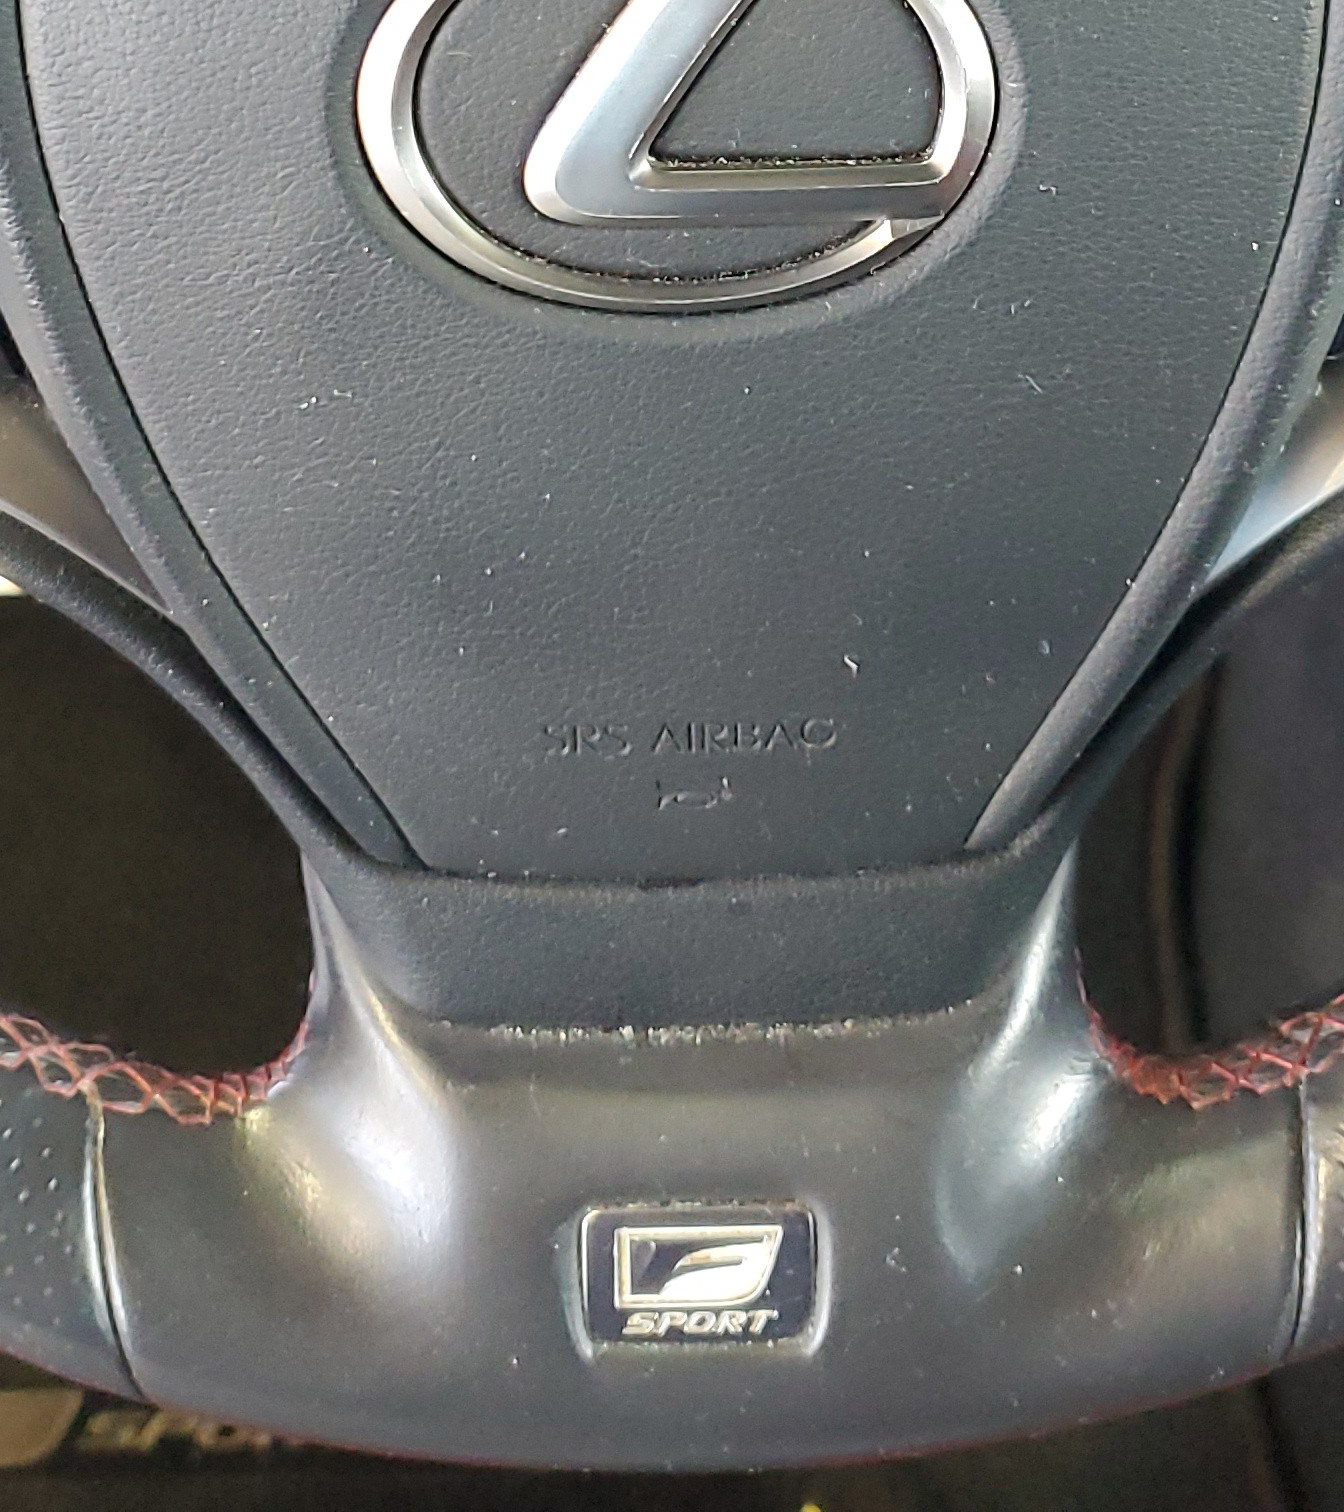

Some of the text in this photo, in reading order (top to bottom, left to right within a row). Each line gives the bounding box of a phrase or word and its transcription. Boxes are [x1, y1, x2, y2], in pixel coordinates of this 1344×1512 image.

[545, 718, 838, 757] SRS AIRBAG
[622, 1309, 779, 1337] SPORT
